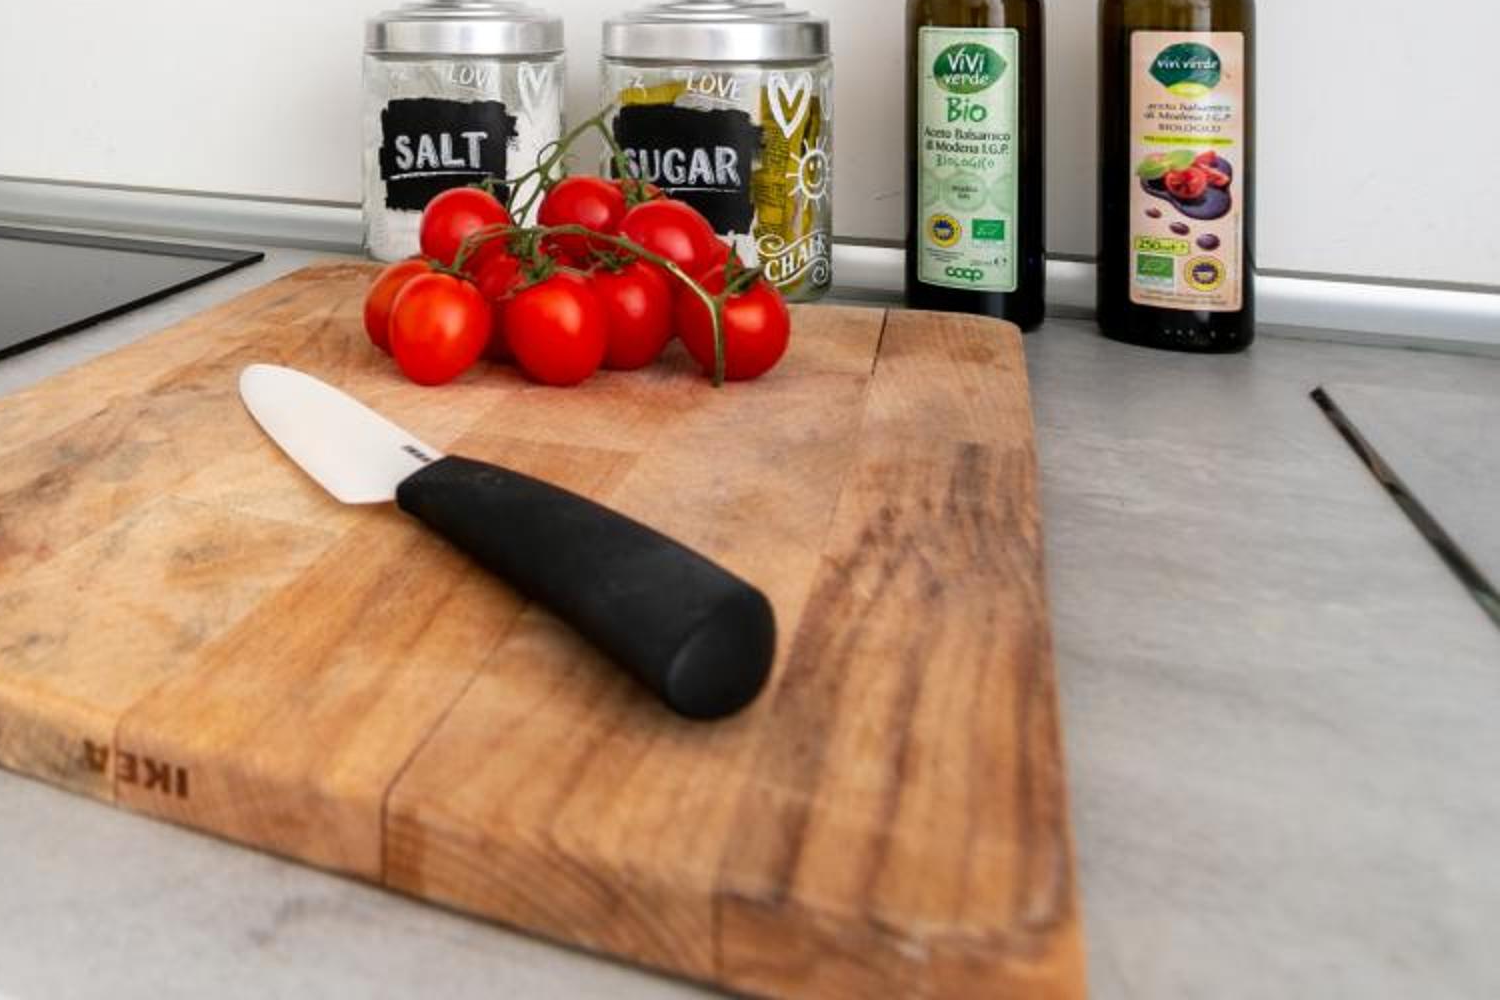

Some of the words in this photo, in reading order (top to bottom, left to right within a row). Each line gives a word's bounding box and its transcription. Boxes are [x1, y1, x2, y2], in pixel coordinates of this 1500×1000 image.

[686, 71, 741, 100] LOVE
[946, 97, 988, 123] Bio
[394, 131, 488, 170] SALT
[935, 141, 979, 155] Modena
[620, 145, 741, 186] SUGAR
[82, 738, 189, 799] IKEA
